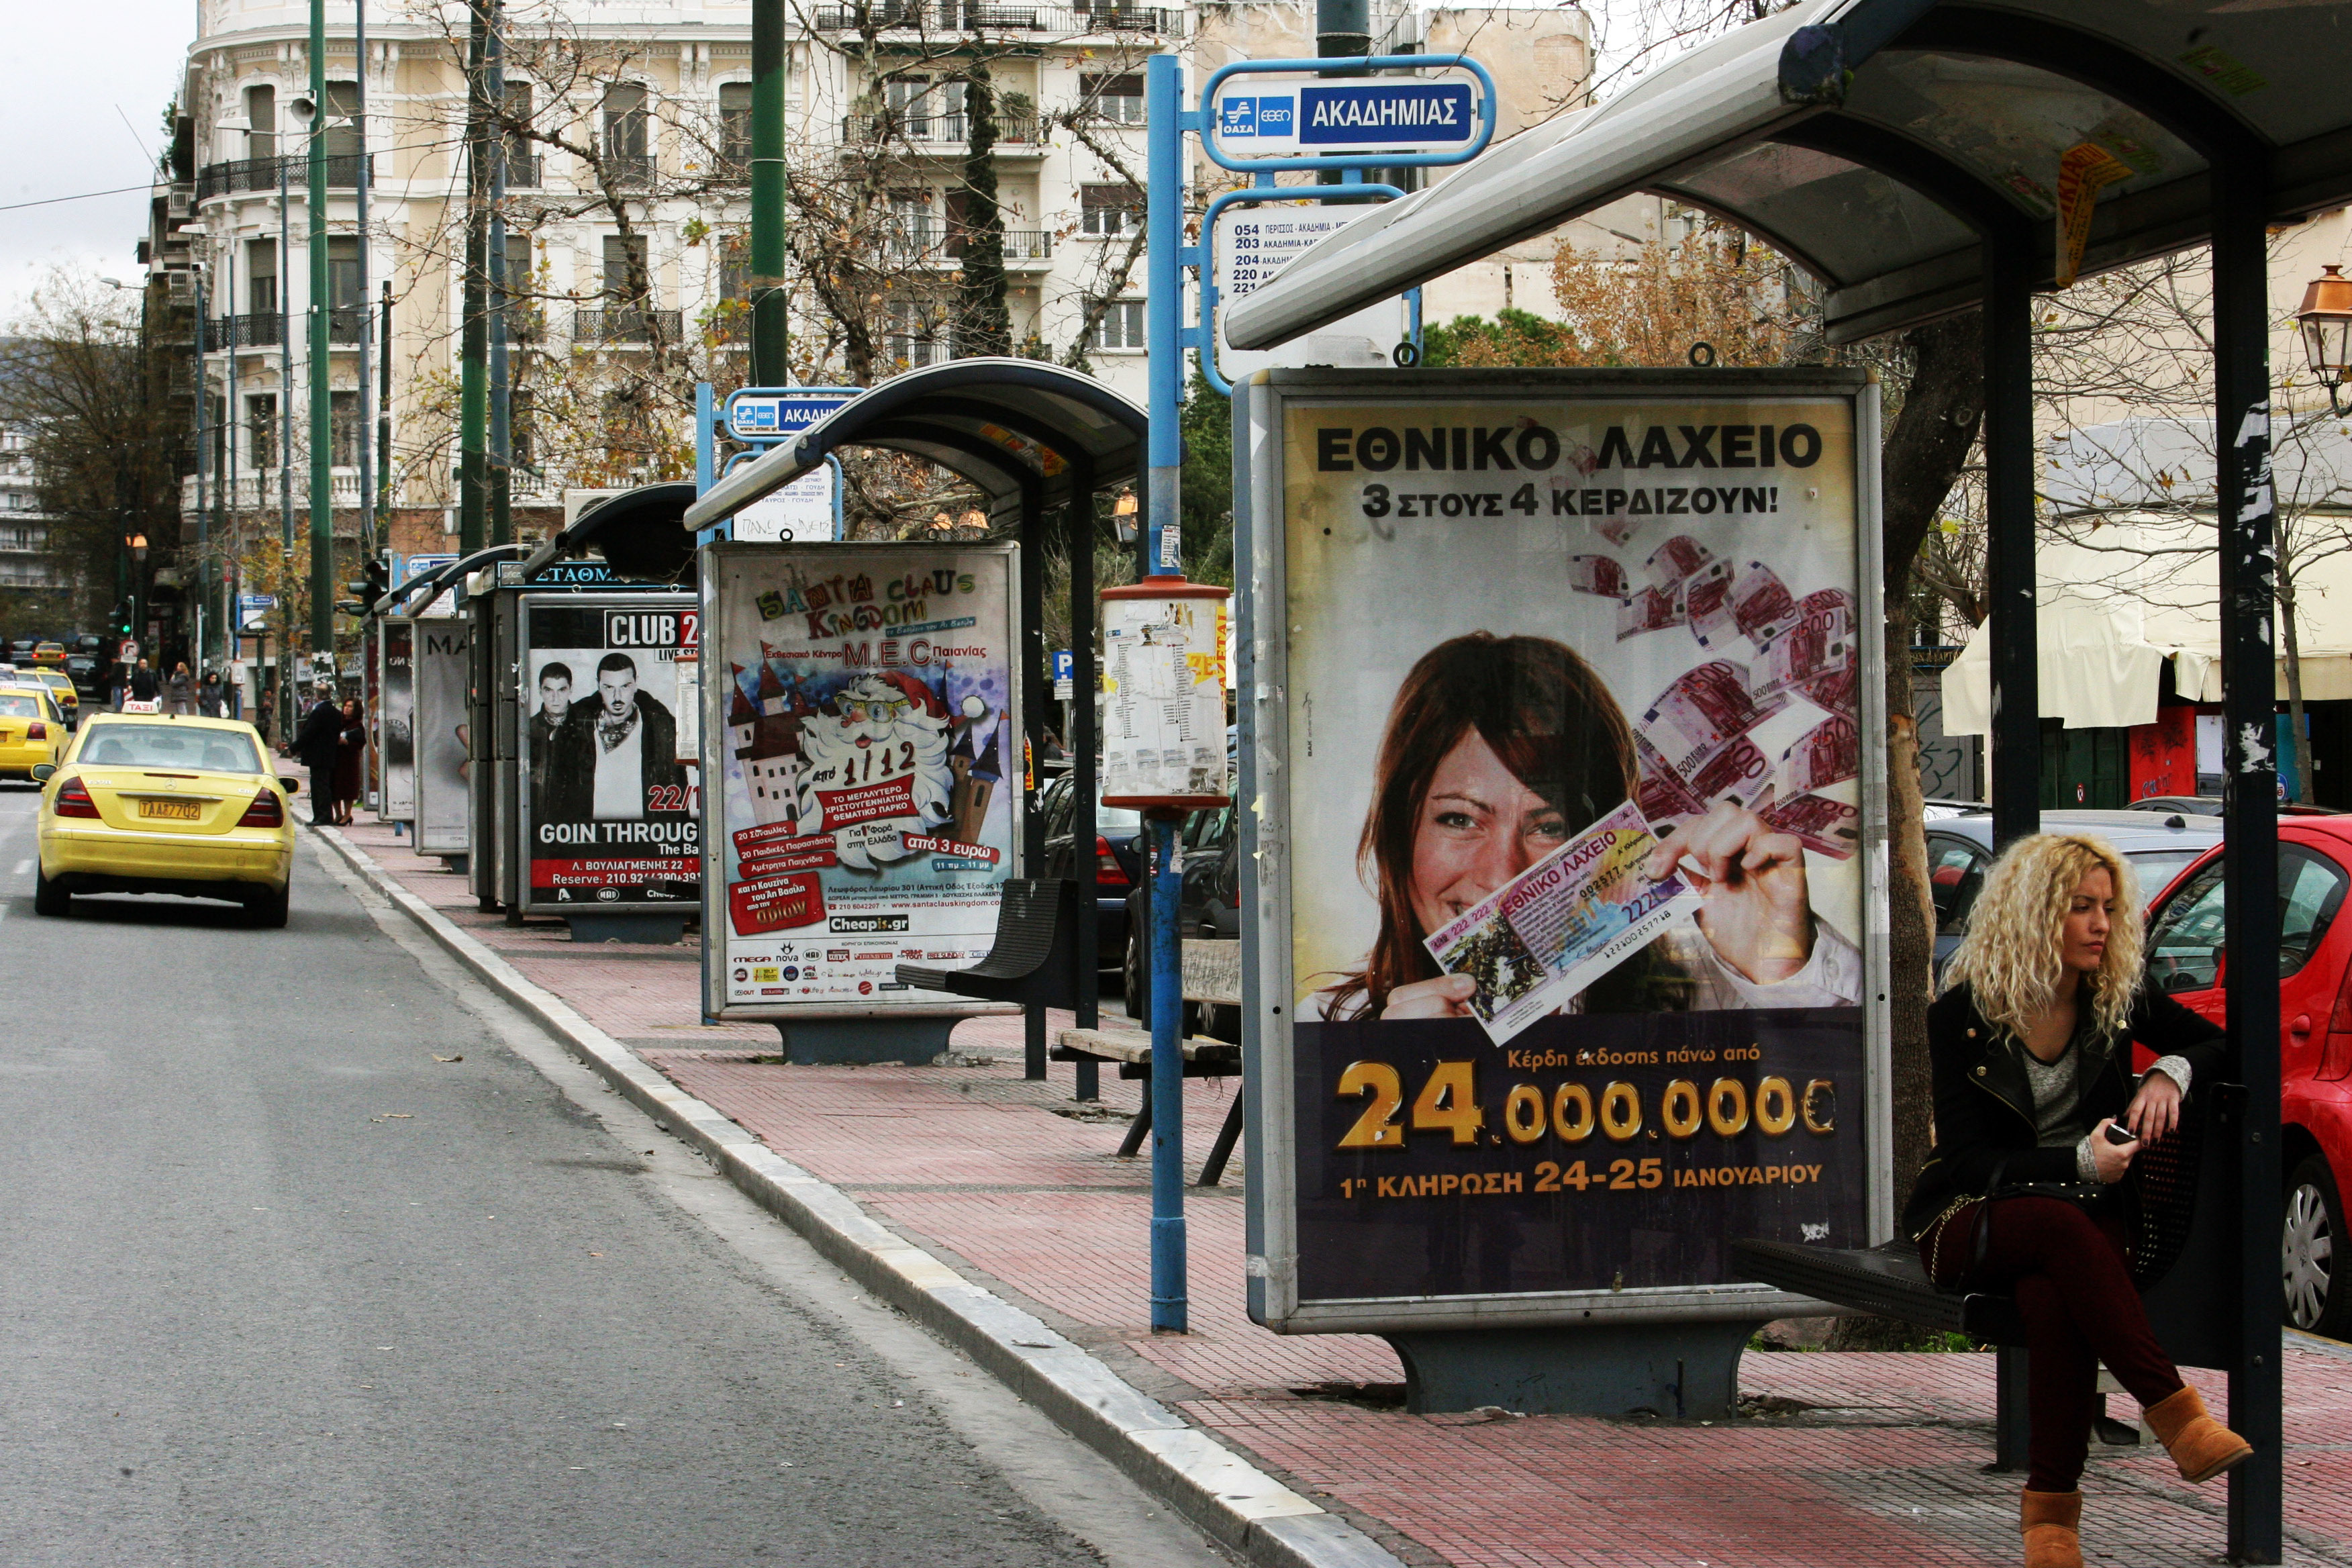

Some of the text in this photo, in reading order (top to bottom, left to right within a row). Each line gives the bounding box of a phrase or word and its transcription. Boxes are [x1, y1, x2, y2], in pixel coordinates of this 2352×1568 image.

[1312, 98, 1457, 127] ΑΚΑΔΗΜΙΑΣ
[1223, 125, 1254, 134] ΟΑΣΑ
[1234, 224, 1259, 236] 054
[1298, 222, 1330, 232] ΑΚΑΔΗΜΙΑ
[1235, 238, 1259, 249] 203
[1235, 255, 1259, 265] 204
[1233, 269, 1257, 280] 220
[1318, 422, 1823, 473] ΕΘΝΙΚΟ ΛΑΧΕΙΟ
[1362, 483, 1779, 519] 3 ΣΤΟΥΣ 4 ΚΕΡΔΙΖΟΥΝ!
[757, 570, 975, 621] SANTA CLAUS
[611, 615, 675, 646] CLUB
[812, 648, 842, 660] Κέντρο
[932, 645, 987, 659] Παιανίας
[1059, 654, 1073, 673] P
[812, 766, 836, 783] από
[1677, 756, 1696, 778] 500
[847, 785, 902, 801] ΜΕΓΑΛΥΤΕΡΟ
[825, 793, 910, 814] ΧΡΙΣΤΟΥΓΕΝΝΙΑΤΙΚΟ
[833, 802, 908, 822] ΘΕΜΑΤΙΚΟ ΠΑΡΚΟ
[540, 822, 698, 843] GOIN THROUG
[846, 834, 897, 848] στην Ελλάδα
[849, 829, 861, 837] Για
[658, 844, 680, 855] The
[753, 845, 785, 858] Παιδικές
[786, 836, 834, 850] Παραστάσεις
[908, 836, 991, 859] από 3 ευρώ
[572, 861, 683, 870] Λ. ΒΟΥΛΙΑΓΜΕΝΗΣ 22
[751, 856, 823, 872] Αμέτρητα Παιχνίδια
[948, 862, 959, 870] πμ
[553, 874, 603, 884] Reserve:
[1502, 869, 1561, 916] ΕΘΝΙΚΟ
[1563, 830, 1617, 876] ΛΑΧΕΙΟ
[738, 886, 750, 894] και
[757, 877, 789, 890] Κουζίνα
[828, 885, 867, 894] Λεωφόρος
[869, 884, 900, 893] Λαυρίου
[901, 883, 915, 891] 301
[916, 883, 944, 891] (Αττική
[945, 882, 965, 890] Οδός
[1579, 866, 1620, 898] 002577
[752, 893, 765, 901] του
[777, 884, 805, 897] Βασίλη
[1621, 892, 1657, 924] 222
[831, 917, 908, 932] Cheapis.gr
[1508, 1044, 1761, 1073] Κέρδη έκδοσης πάνω από
[1336, 1059, 1837, 1148] 24.000.000€
[1377, 1171, 1523, 1197] ΚΛΗΡΩΣΗ
[1534, 1157, 1663, 1193] 24-25
[1673, 1163, 1822, 1187] ΙΑΝΟΥΑΡΙΟΥ
